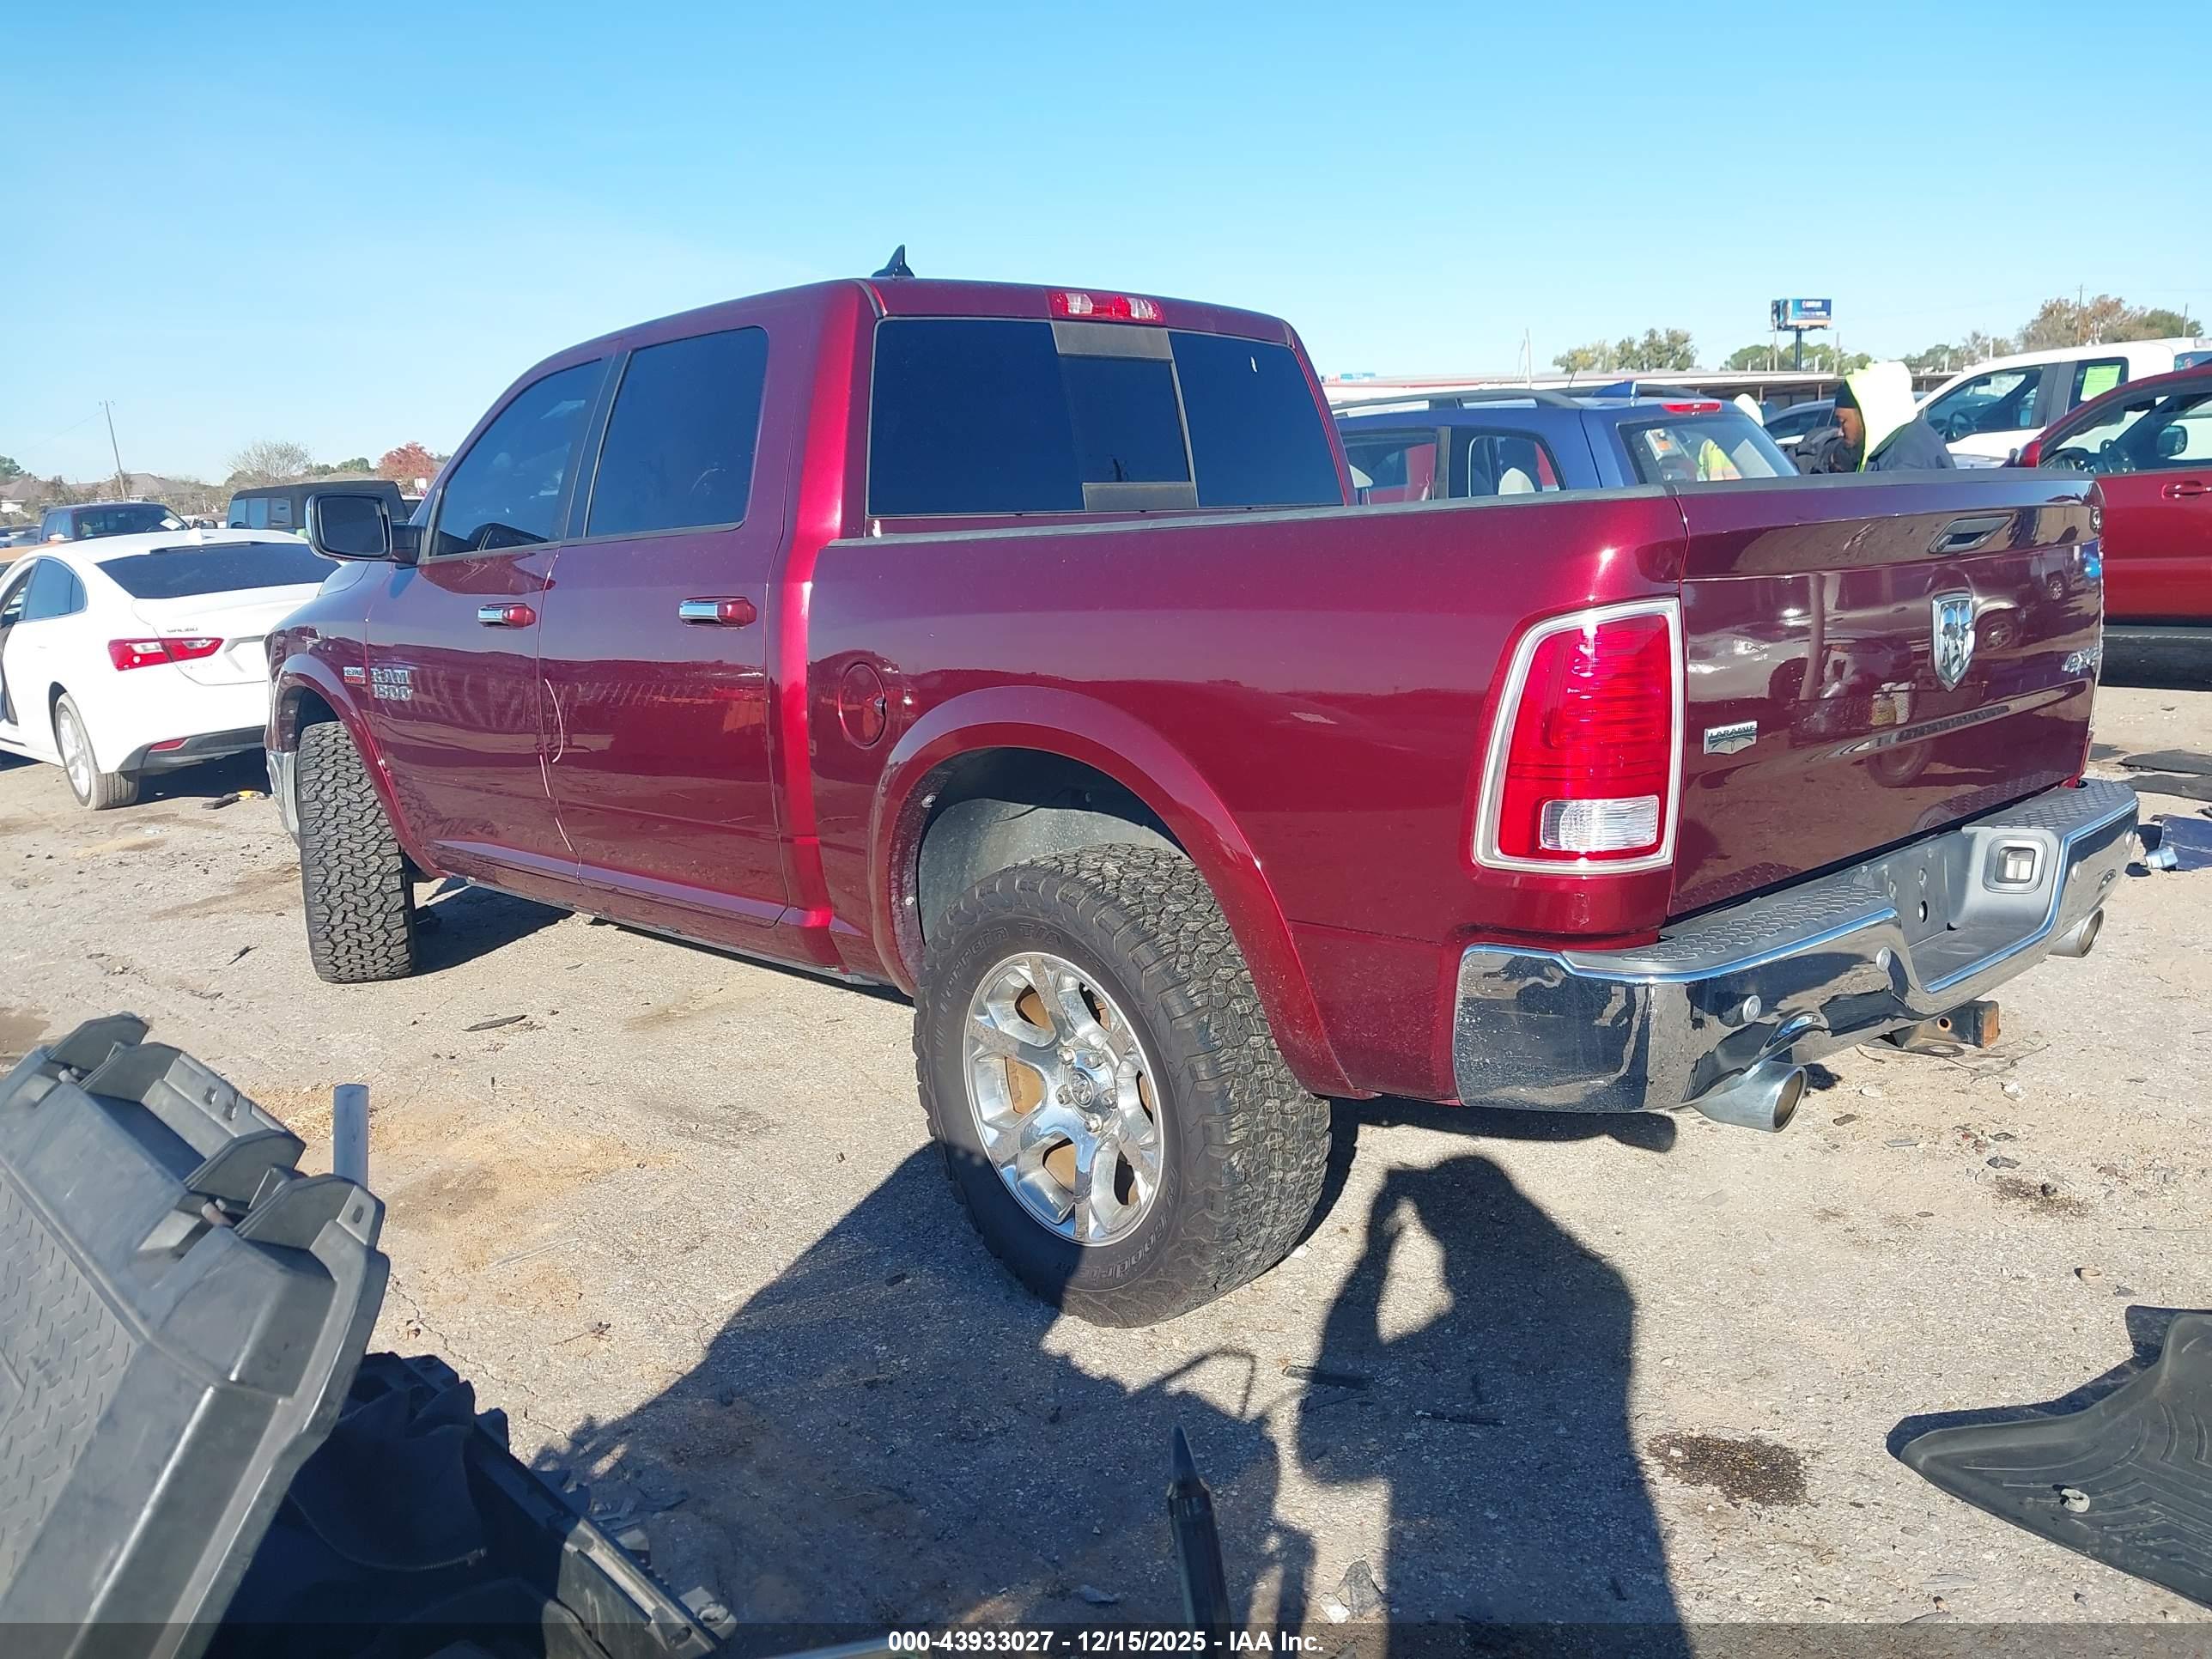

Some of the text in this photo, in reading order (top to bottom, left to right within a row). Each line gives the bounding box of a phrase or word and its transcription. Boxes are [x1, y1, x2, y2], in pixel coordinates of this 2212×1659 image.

[370, 668, 410, 684] RAM
[372, 684, 412, 701] 1500
[1710, 725, 1755, 738] LARAMIE
